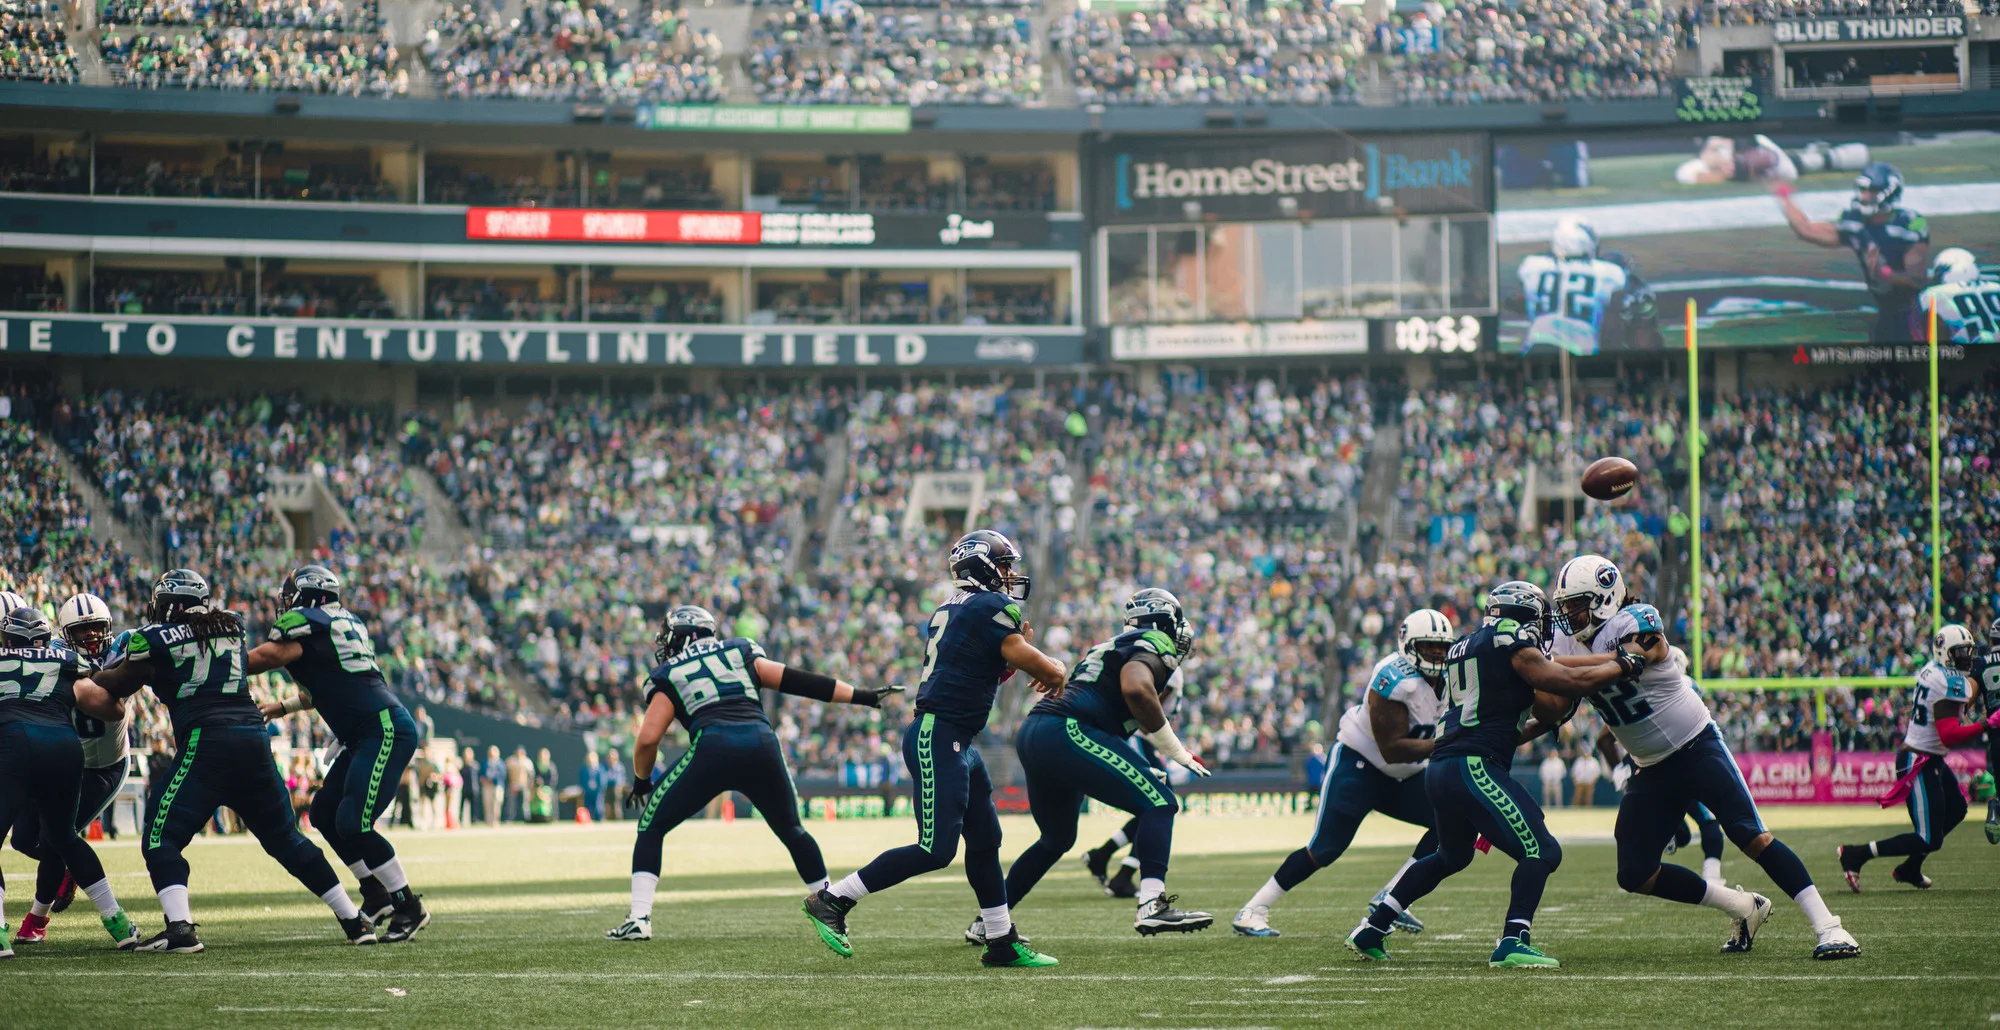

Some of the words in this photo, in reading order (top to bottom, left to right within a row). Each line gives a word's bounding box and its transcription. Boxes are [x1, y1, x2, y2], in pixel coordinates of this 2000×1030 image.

[1776, 21, 1840, 41] BLUE
[1845, 16, 1964, 39] THUNDER
[1386, 149, 1473, 189] Bank
[1536, 271, 1597, 324] 92
[101, 323, 177, 355] TO
[227, 324, 694, 364] CENTURYLINK
[741, 334, 927, 365] FIELD
[1395, 316, 1481, 353] 10:52
[1810, 346, 1893, 365] MITSUBISHI
[1895, 344, 1965, 363] ELECRIC
[169, 636, 242, 698] 77
[668, 640, 726, 665] SWEEZY
[668, 648, 760, 716] 64
[1436, 657, 1480, 738] 4
[1750, 765, 1765, 785] A
[1767, 762, 1858, 785] CRUAL
